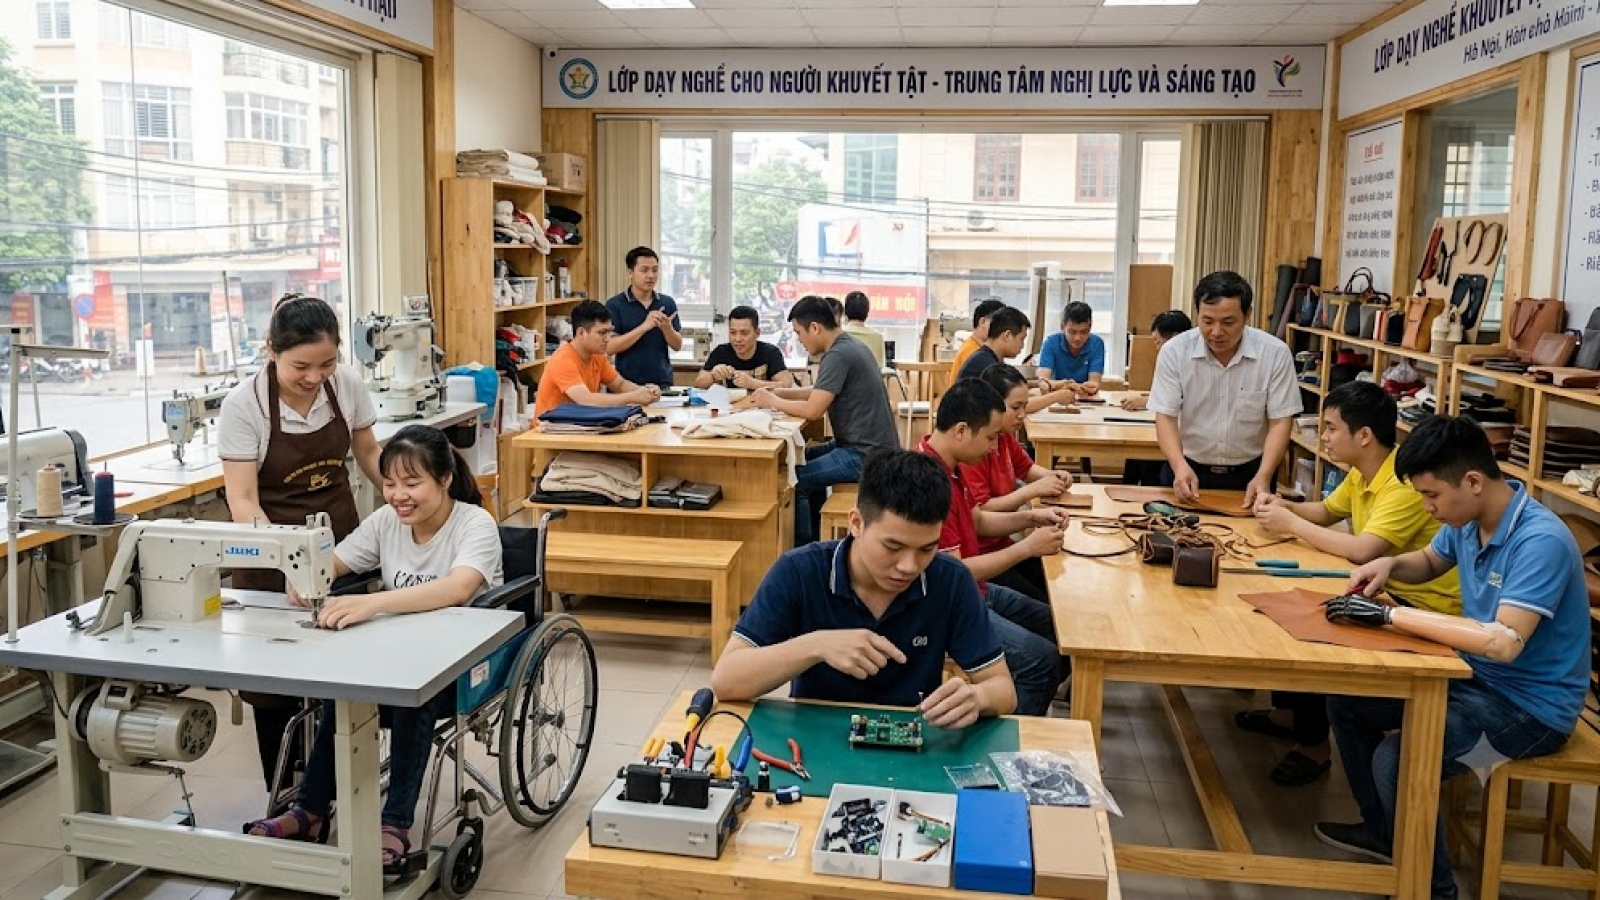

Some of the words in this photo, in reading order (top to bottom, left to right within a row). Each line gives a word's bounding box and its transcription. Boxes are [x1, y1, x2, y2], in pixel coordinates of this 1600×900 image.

[1397, 28, 1420, 66] DẠY
[608, 64, 639, 93] LỚP
[644, 70, 676, 98] DẠY
[731, 70, 764, 93] CHO
[769, 64, 822, 93] NGƯỜI
[827, 62, 892, 93] KHUYẾT
[897, 65, 928, 99] TẬT
[945, 70, 1001, 93] TRUNG
[1007, 65, 1045, 93] TÂM
[1050, 70, 1093, 98] NGHỊ
[1098, 68, 1133, 98] LỰC
[1138, 64, 1161, 93] VÀ
[1166, 64, 1216, 93] SÁNG
[1221, 69, 1257, 98] TẠO
[225, 546, 260, 557] JUKI
